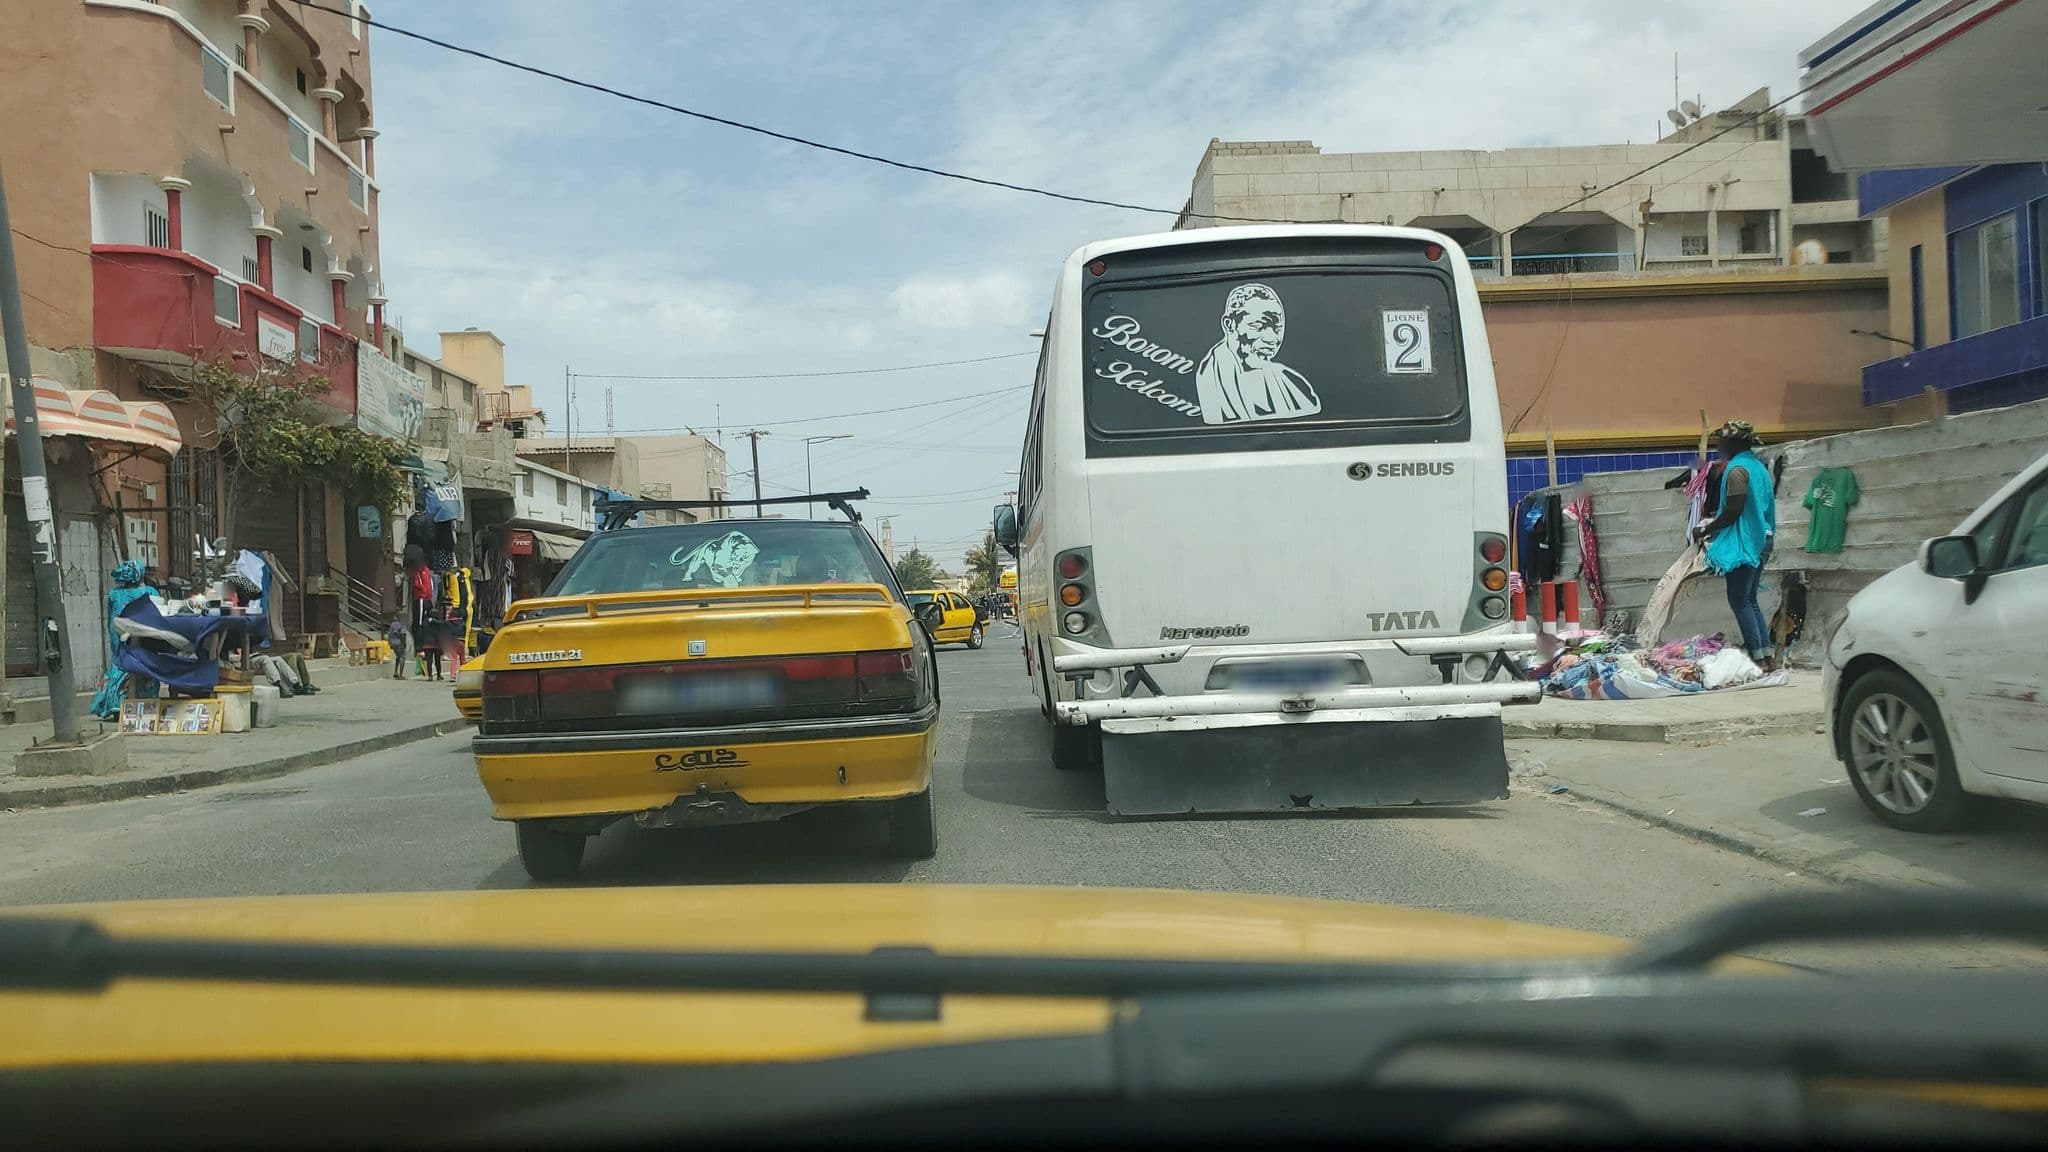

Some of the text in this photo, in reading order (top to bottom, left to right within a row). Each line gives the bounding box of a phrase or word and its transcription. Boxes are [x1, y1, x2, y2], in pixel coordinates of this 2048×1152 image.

[1387, 313, 1424, 323] LIGNE
[1093, 315, 1194, 374] Borom
[1393, 323, 1424, 372] 2
[368, 344, 409, 384] OUPE
[1376, 462, 1455, 477] SENBUS
[1366, 610, 1441, 632] TATA
[1159, 624, 1250, 640] Marcopolo
[509, 649, 583, 664] RENAULT 21
